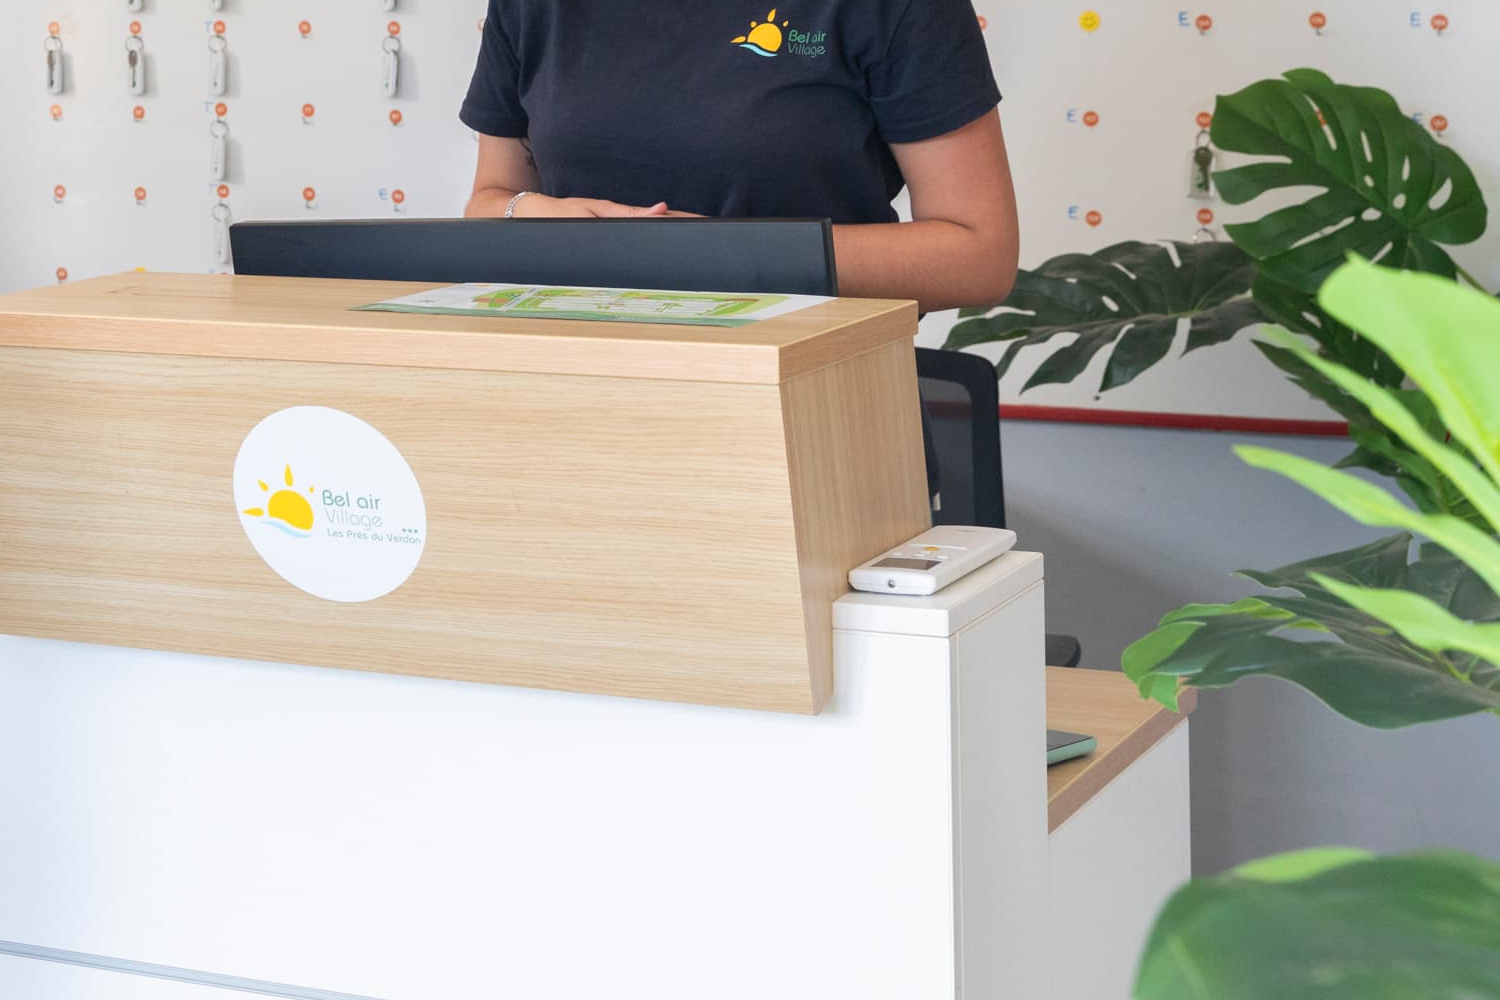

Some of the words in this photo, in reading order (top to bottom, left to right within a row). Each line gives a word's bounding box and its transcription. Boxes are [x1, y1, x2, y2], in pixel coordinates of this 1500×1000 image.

[788, 29, 811, 43] Bel
[811, 29, 827, 42] air
[788, 42, 826, 58] Village
[322, 489, 350, 507] Bel
[356, 493, 381, 510] air
[324, 507, 383, 530] Village
[326, 528, 344, 538] Les
[371, 531, 384, 541] du
[386, 534, 421, 545] Verdon
